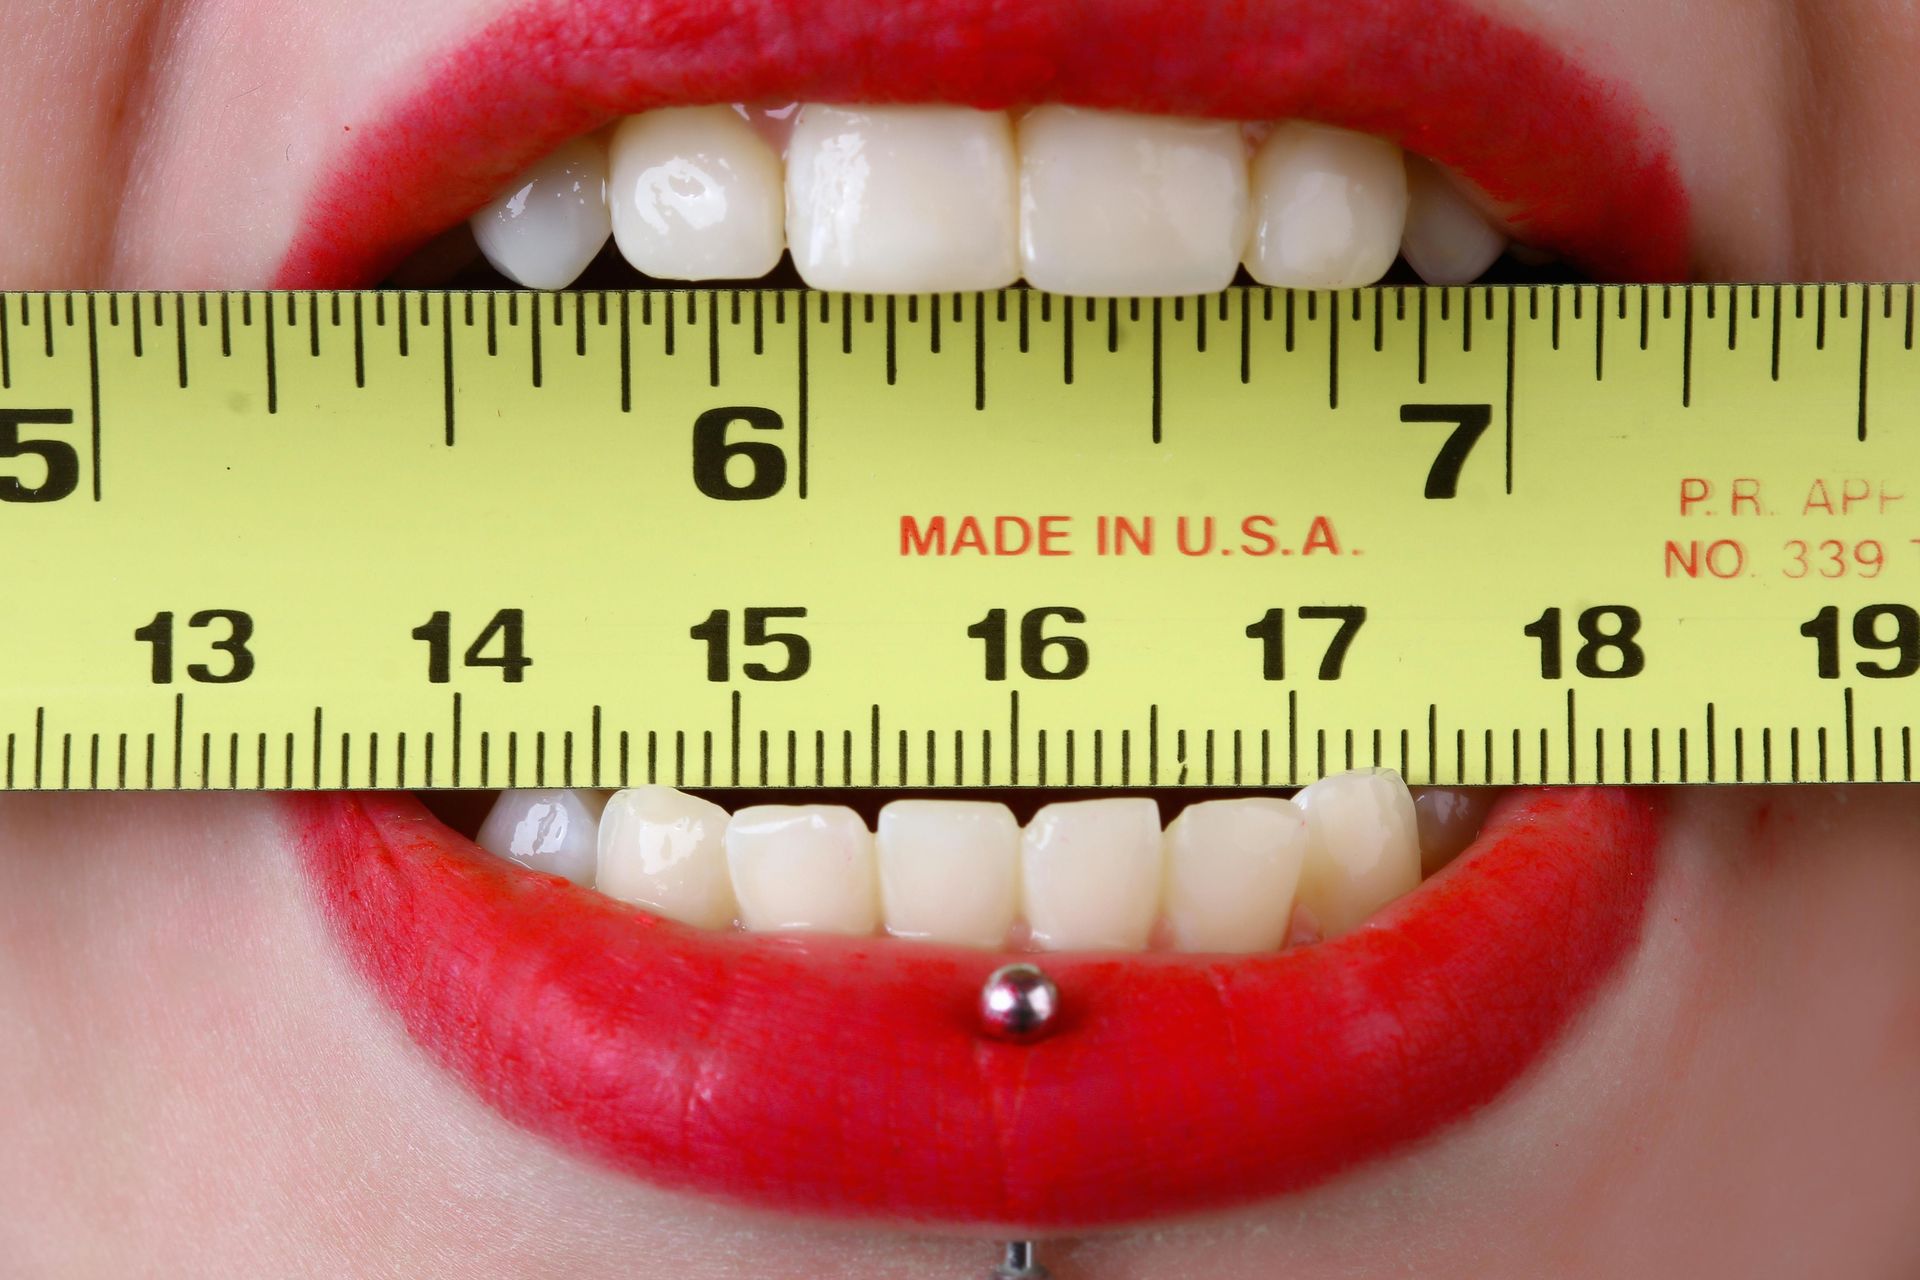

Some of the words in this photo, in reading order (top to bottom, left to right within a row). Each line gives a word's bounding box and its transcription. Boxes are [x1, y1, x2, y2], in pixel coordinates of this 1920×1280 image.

[0, 408, 79, 503] 5
[692, 406, 787, 501] 6
[1399, 403, 1493, 500] 7
[898, 514, 1073, 558] MADE
[1095, 514, 1156, 558] IN
[1175, 514, 1366, 558] U.S.A.
[1782, 537, 1887, 581] 339
[134, 608, 255, 685] 13
[412, 608, 532, 684] 14
[690, 606, 811, 684] 15
[967, 606, 1089, 682] 16
[1245, 606, 1367, 682] 17
[1523, 604, 1645, 680] 18
[1800, 603, 1920, 680] 19
